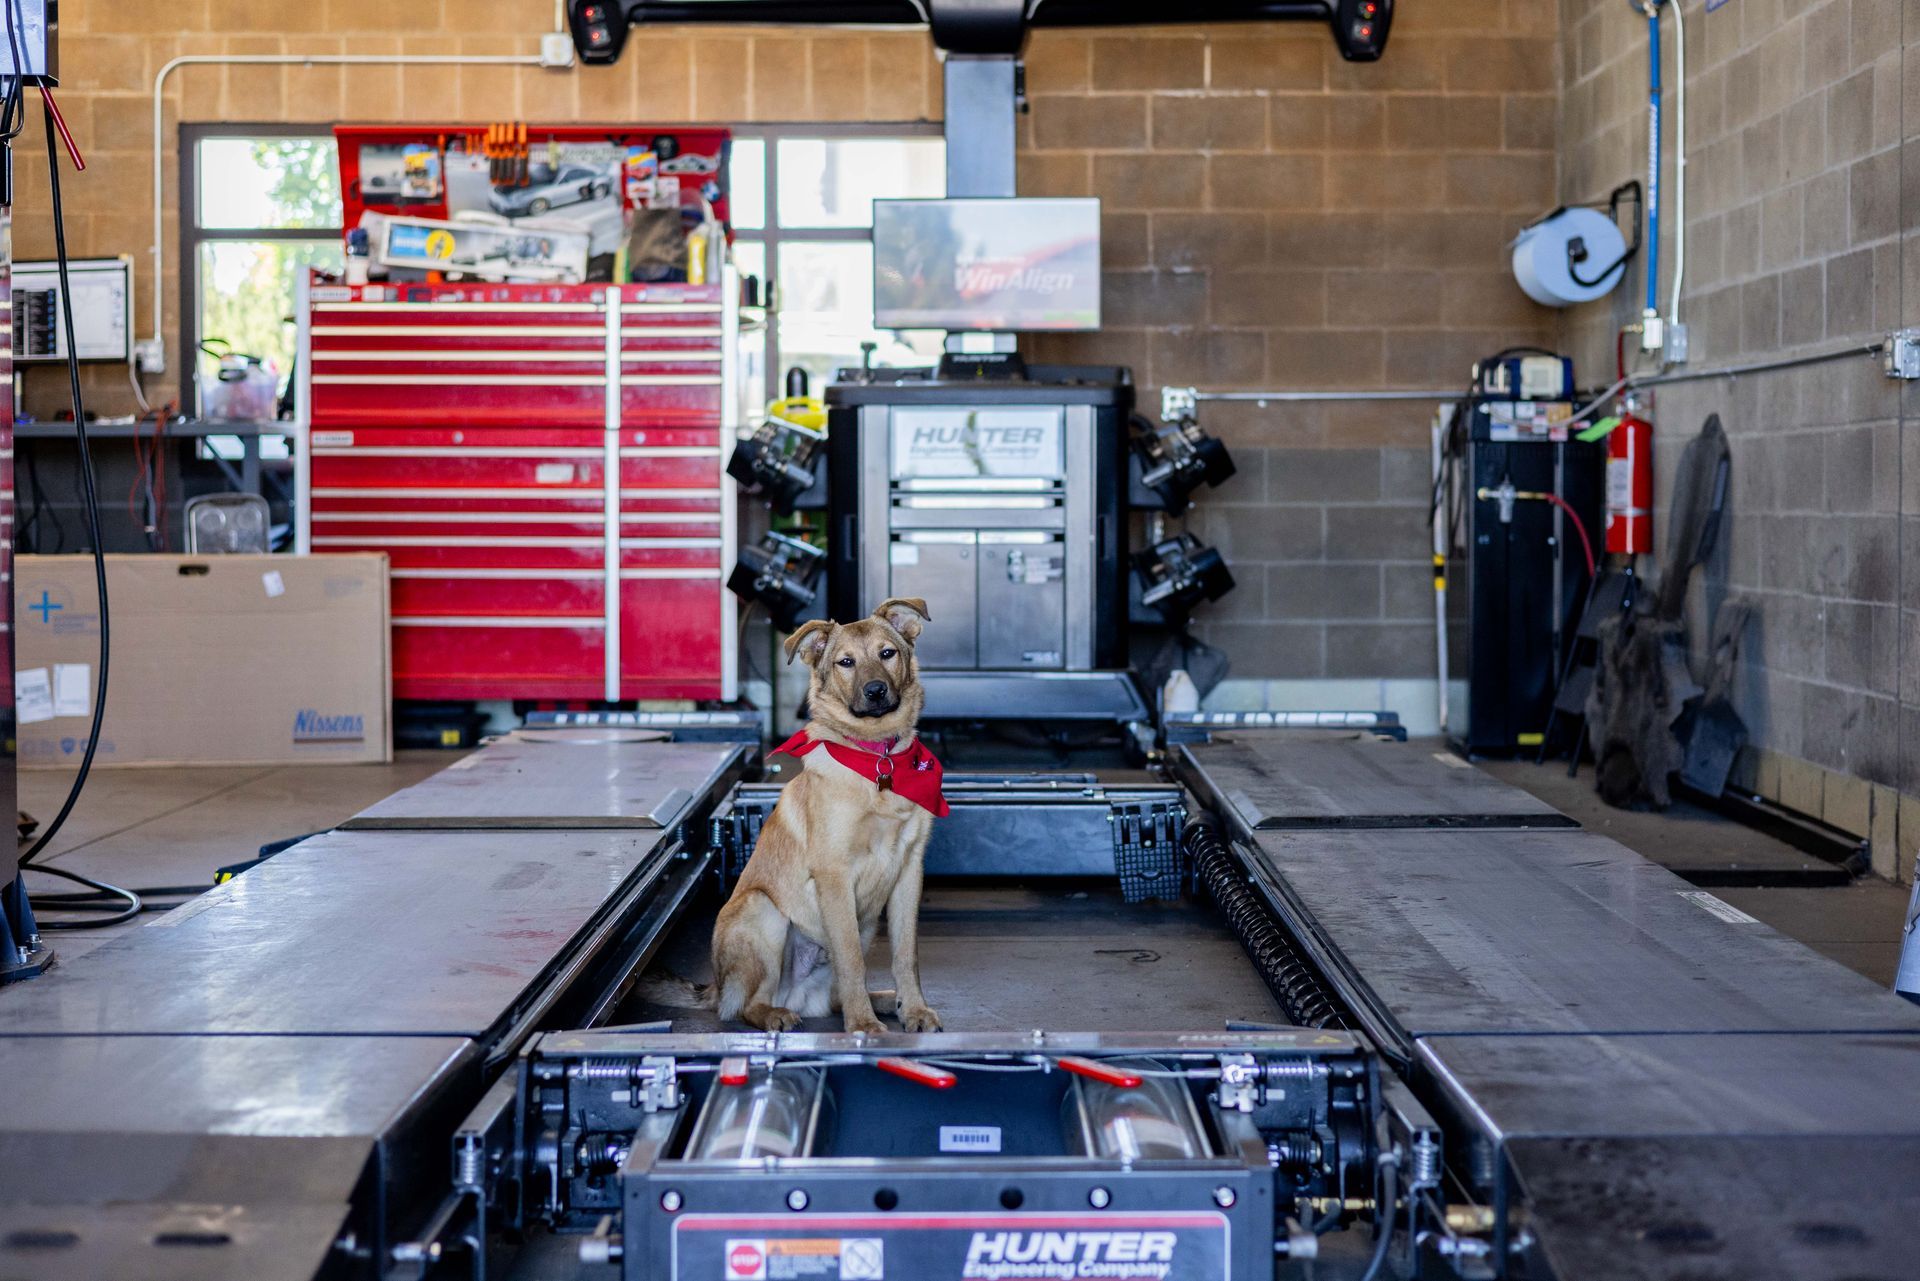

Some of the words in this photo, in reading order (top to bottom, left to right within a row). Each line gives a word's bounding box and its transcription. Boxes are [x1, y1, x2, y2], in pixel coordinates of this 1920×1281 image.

[955, 267, 1075, 292] WinAlign
[292, 708, 364, 735] Nissens
[967, 1232, 1177, 1262] HUNTER
[962, 1261, 1077, 1281] Engineering
